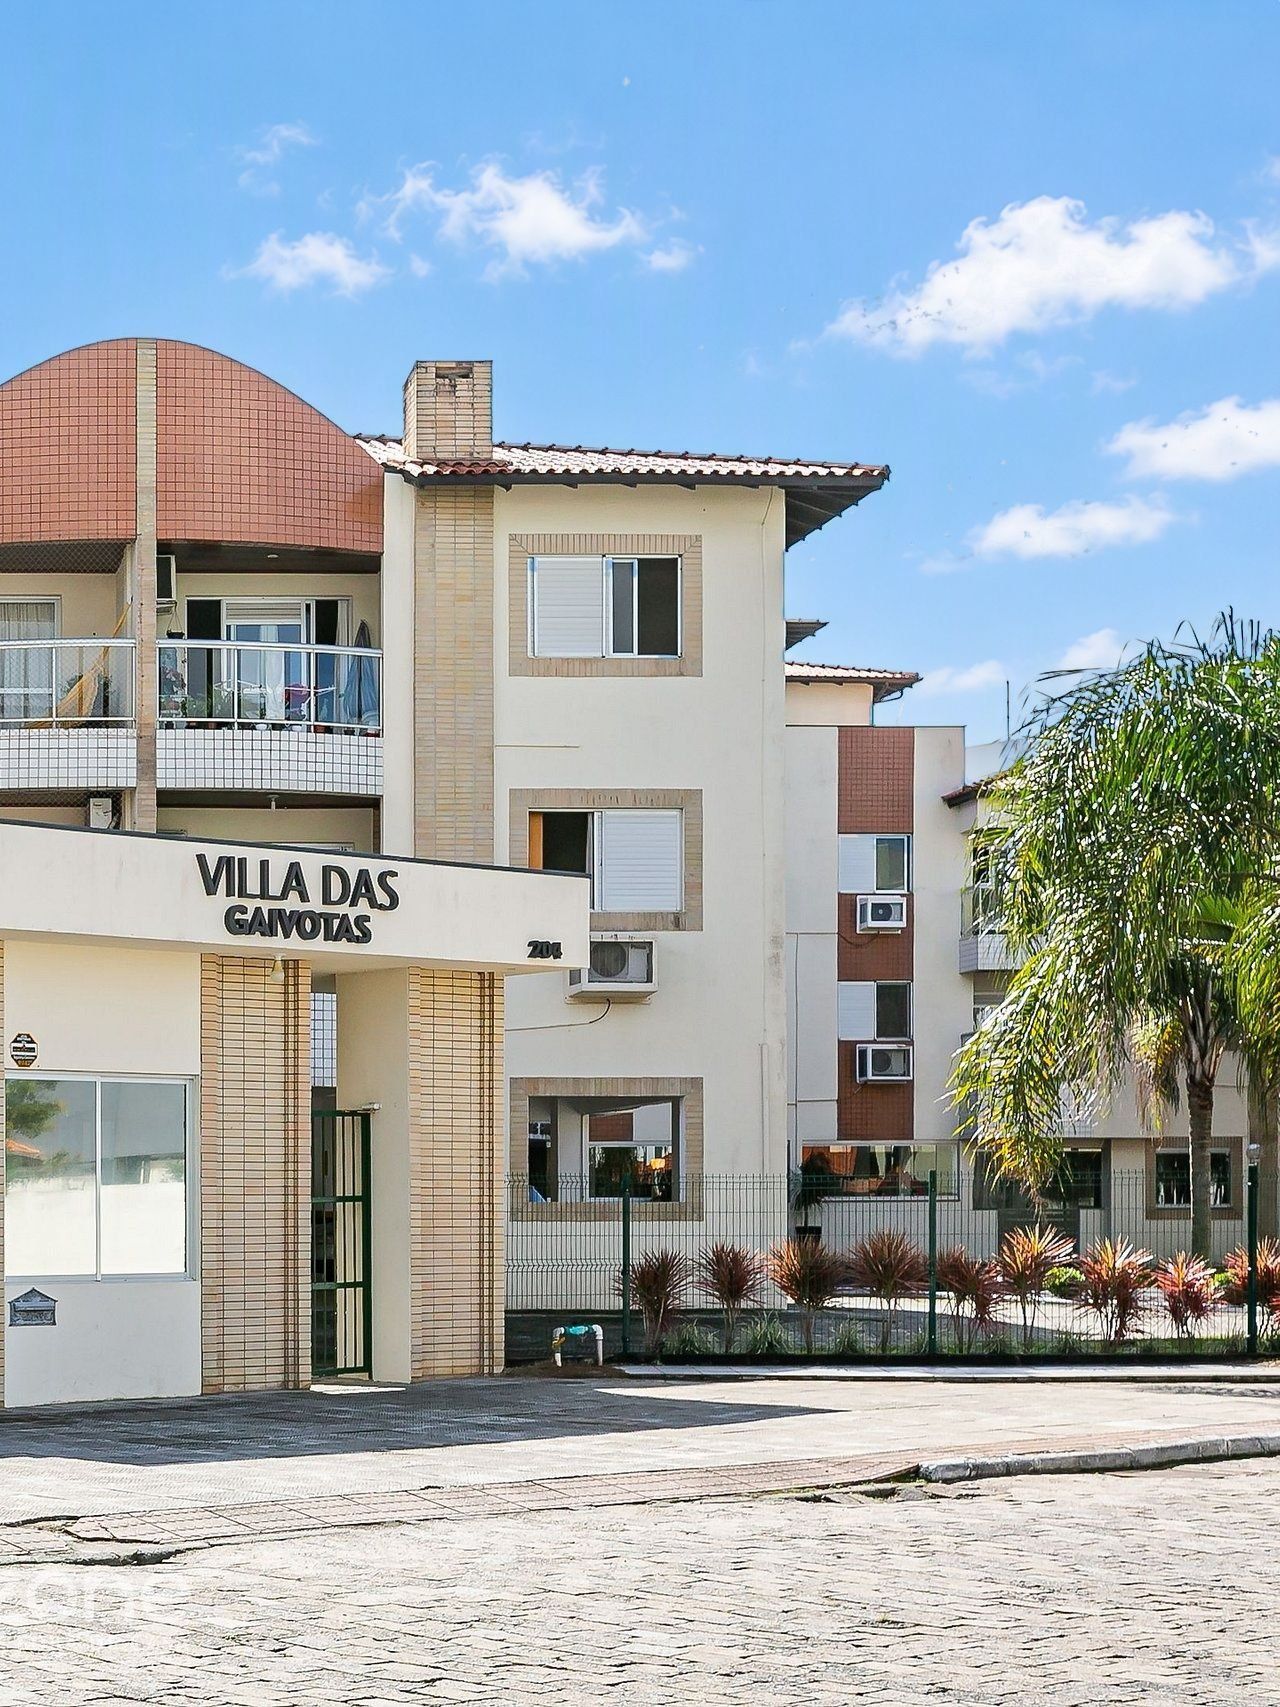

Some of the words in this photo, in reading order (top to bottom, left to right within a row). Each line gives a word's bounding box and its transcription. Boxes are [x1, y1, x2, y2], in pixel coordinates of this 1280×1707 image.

[196, 853, 310, 902] VILLA
[322, 865, 400, 911] DAS
[224, 904, 373, 943] GAIVOTAS
